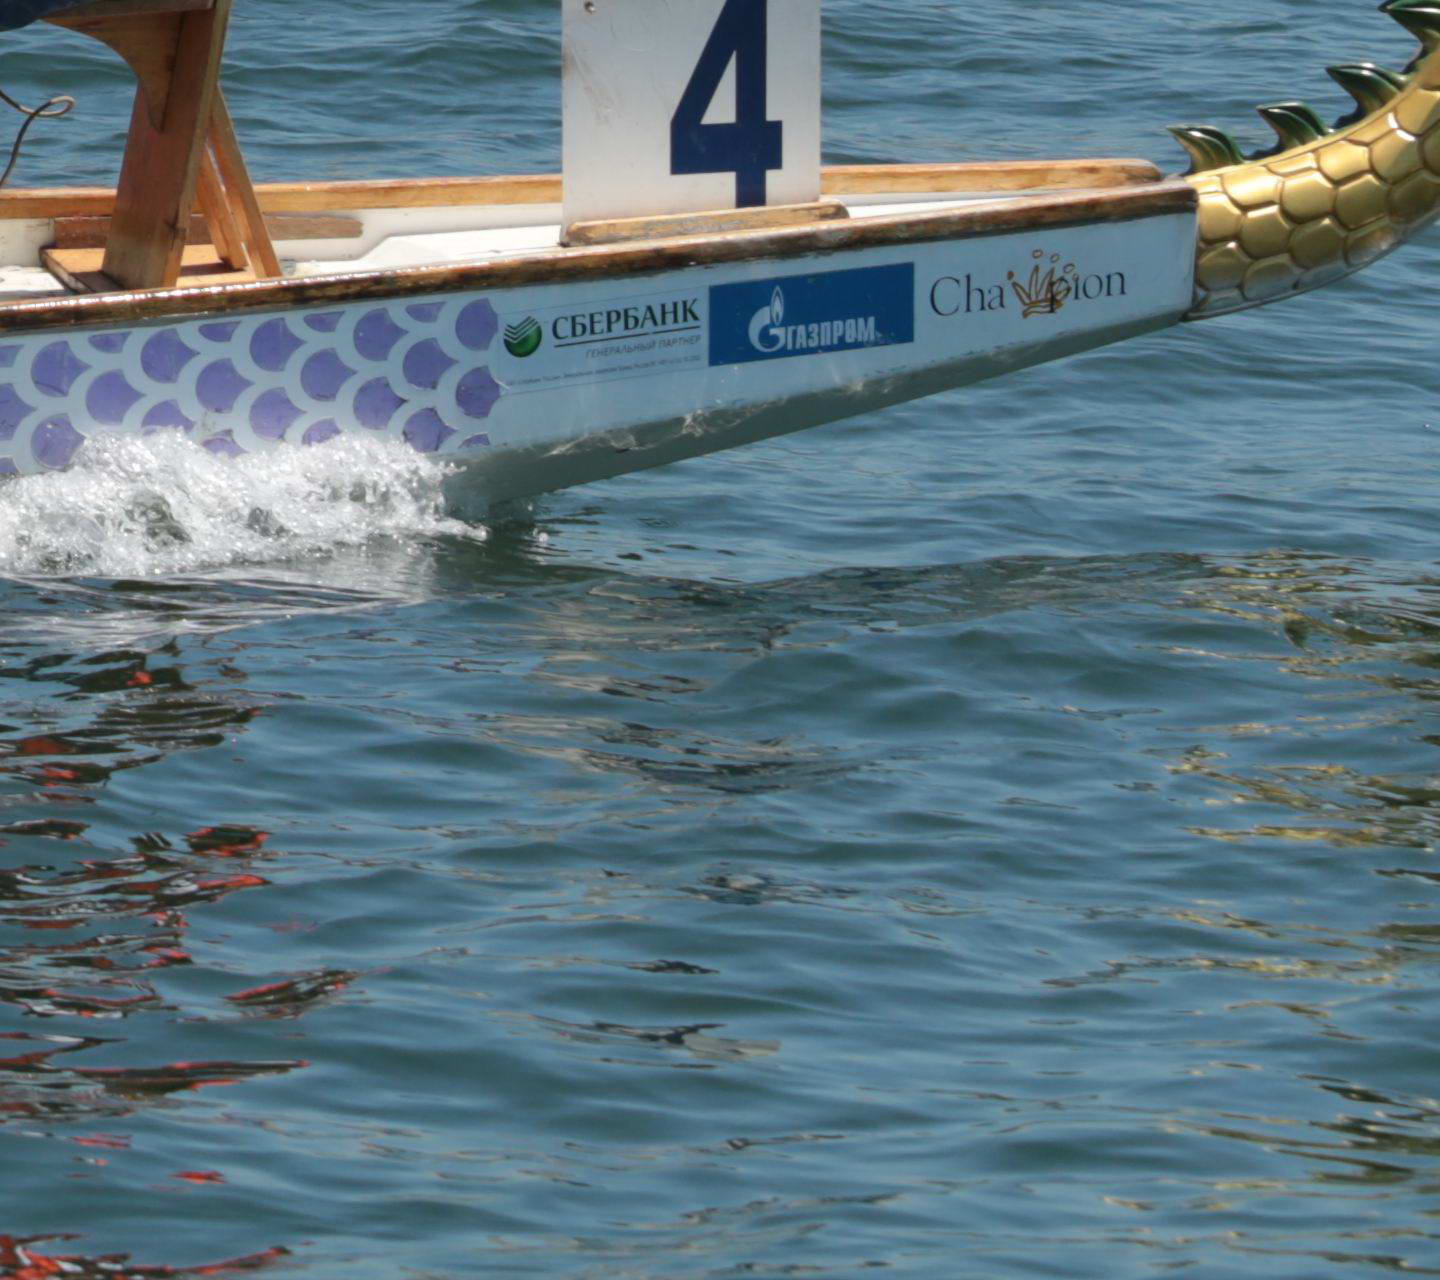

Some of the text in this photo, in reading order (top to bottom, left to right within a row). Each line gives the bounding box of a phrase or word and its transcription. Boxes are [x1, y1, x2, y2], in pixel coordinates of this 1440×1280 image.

[552, 297, 701, 340] СБЕРБАНК
[785, 316, 876, 351] ГАЗПРОМ
[584, 333, 702, 360] ГЕНЕРАЛЬНЫЙ ПАРТНЕР
